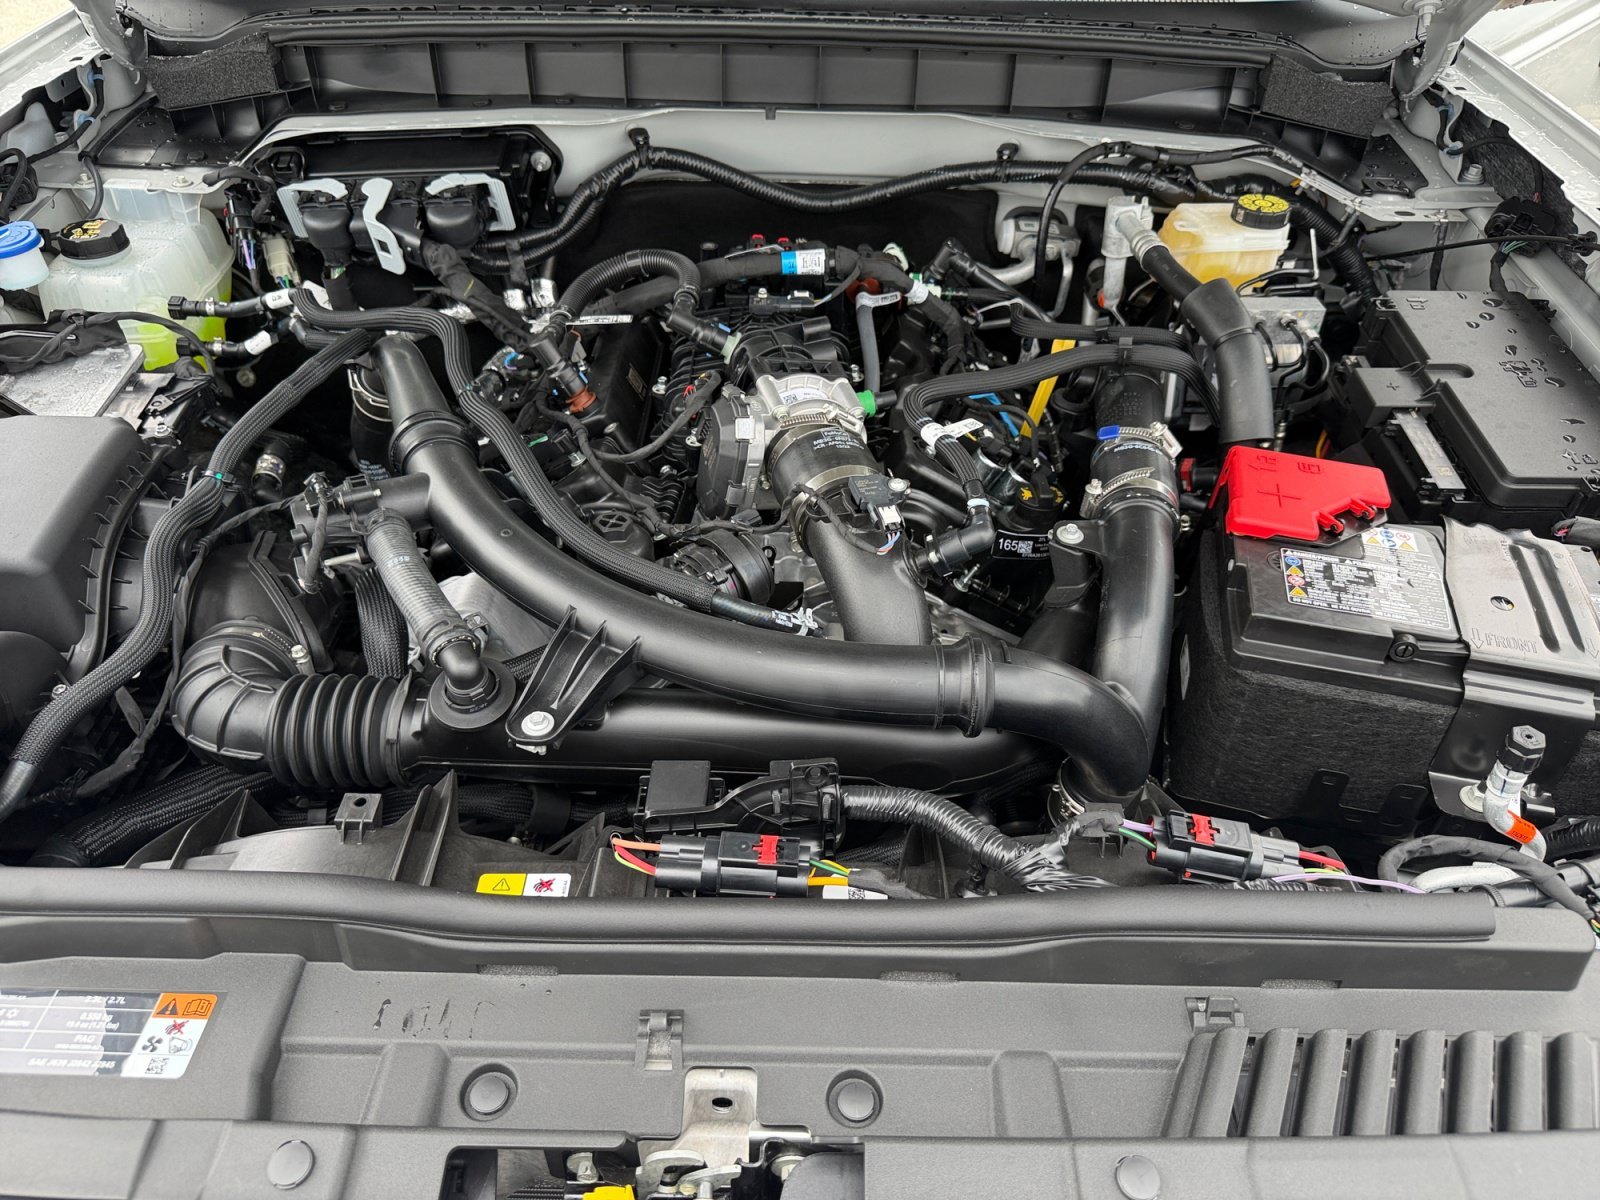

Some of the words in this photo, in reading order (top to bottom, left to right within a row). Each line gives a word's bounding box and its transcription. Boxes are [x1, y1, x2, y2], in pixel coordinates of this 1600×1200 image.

[998, 537, 1019, 551] 165
[1485, 632, 1538, 654] FRONT
[107, 996, 126, 1005] 2.7L
[73, 1034, 96, 1043] PAG
